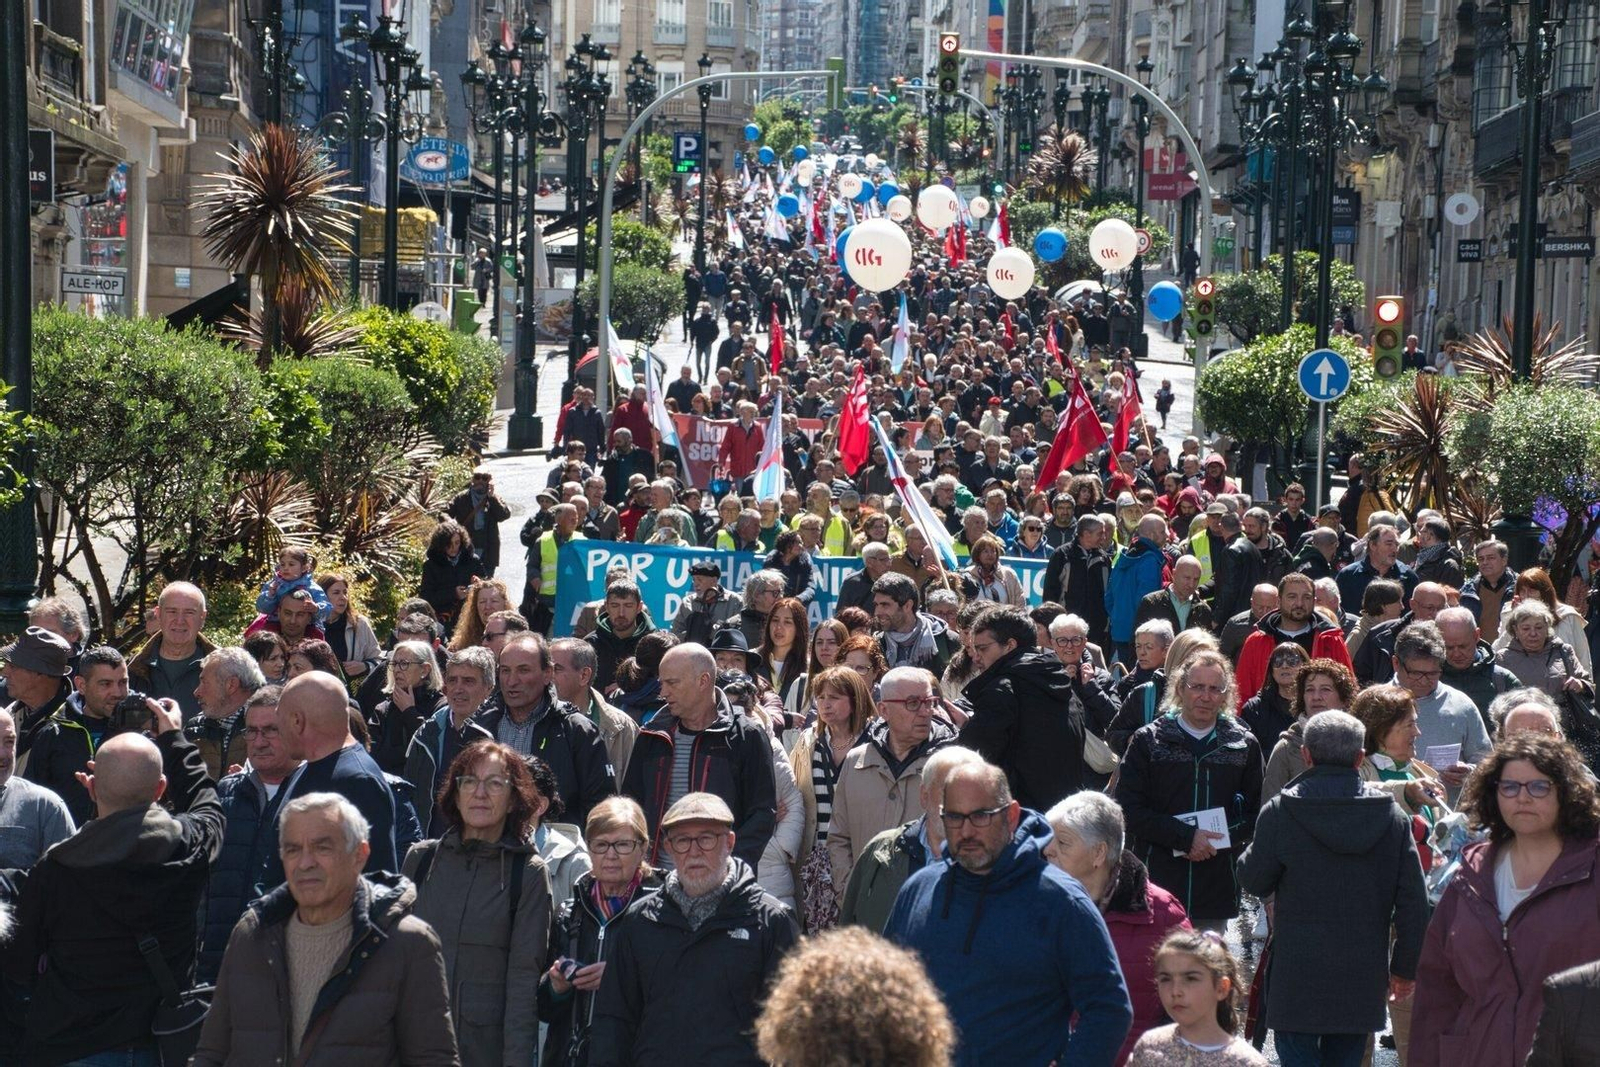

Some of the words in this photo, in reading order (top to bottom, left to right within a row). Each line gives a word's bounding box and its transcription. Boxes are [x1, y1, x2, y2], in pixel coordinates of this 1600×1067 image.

[679, 137, 697, 158] P
[1333, 195, 1349, 204] lloa
[1545, 242, 1591, 252] BERSHKA
[67, 276, 119, 291] ALE-HOP
